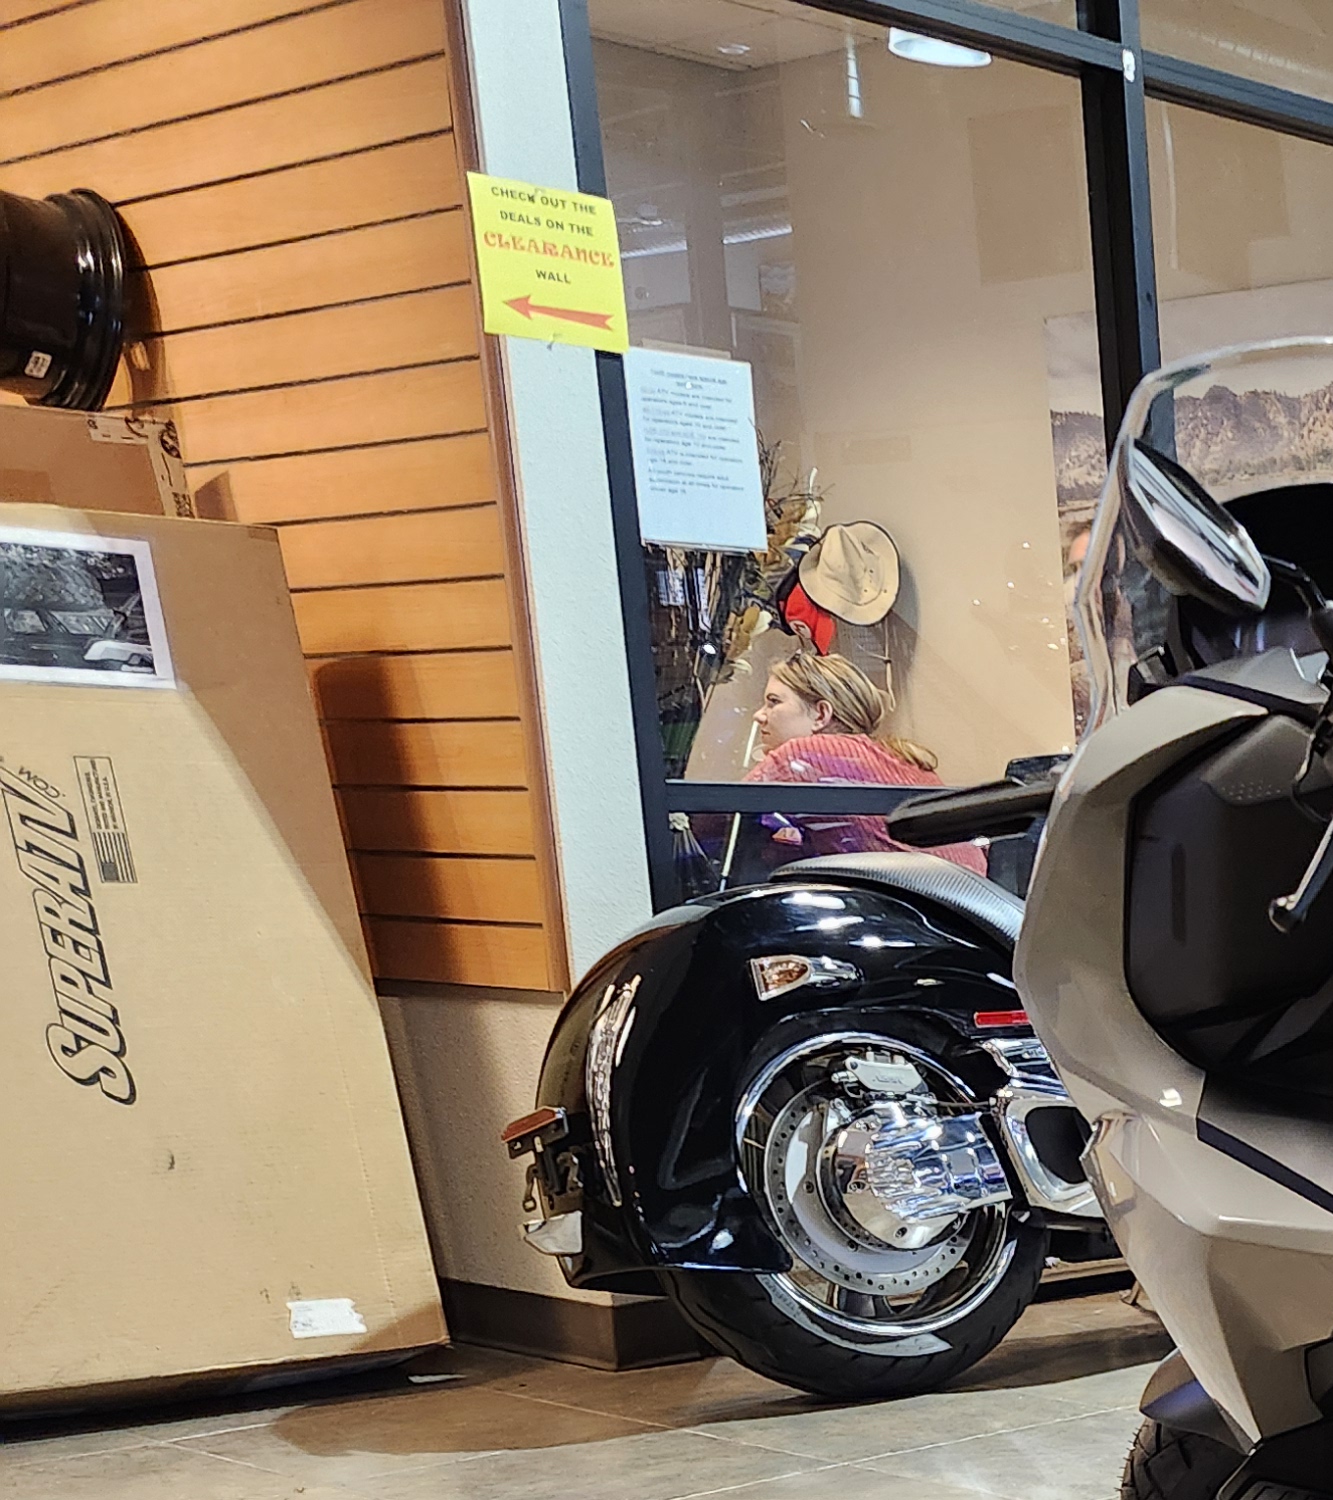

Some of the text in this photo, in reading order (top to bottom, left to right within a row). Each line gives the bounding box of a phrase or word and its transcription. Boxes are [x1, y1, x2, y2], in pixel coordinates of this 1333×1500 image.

[490, 186, 597, 215] CHECK OUT THE
[500, 210, 594, 236] DEALS ON THE
[483, 231, 615, 268] CLEARANCE
[535, 269, 572, 284] WALL
[0, 764, 137, 1106] SUPERATV
